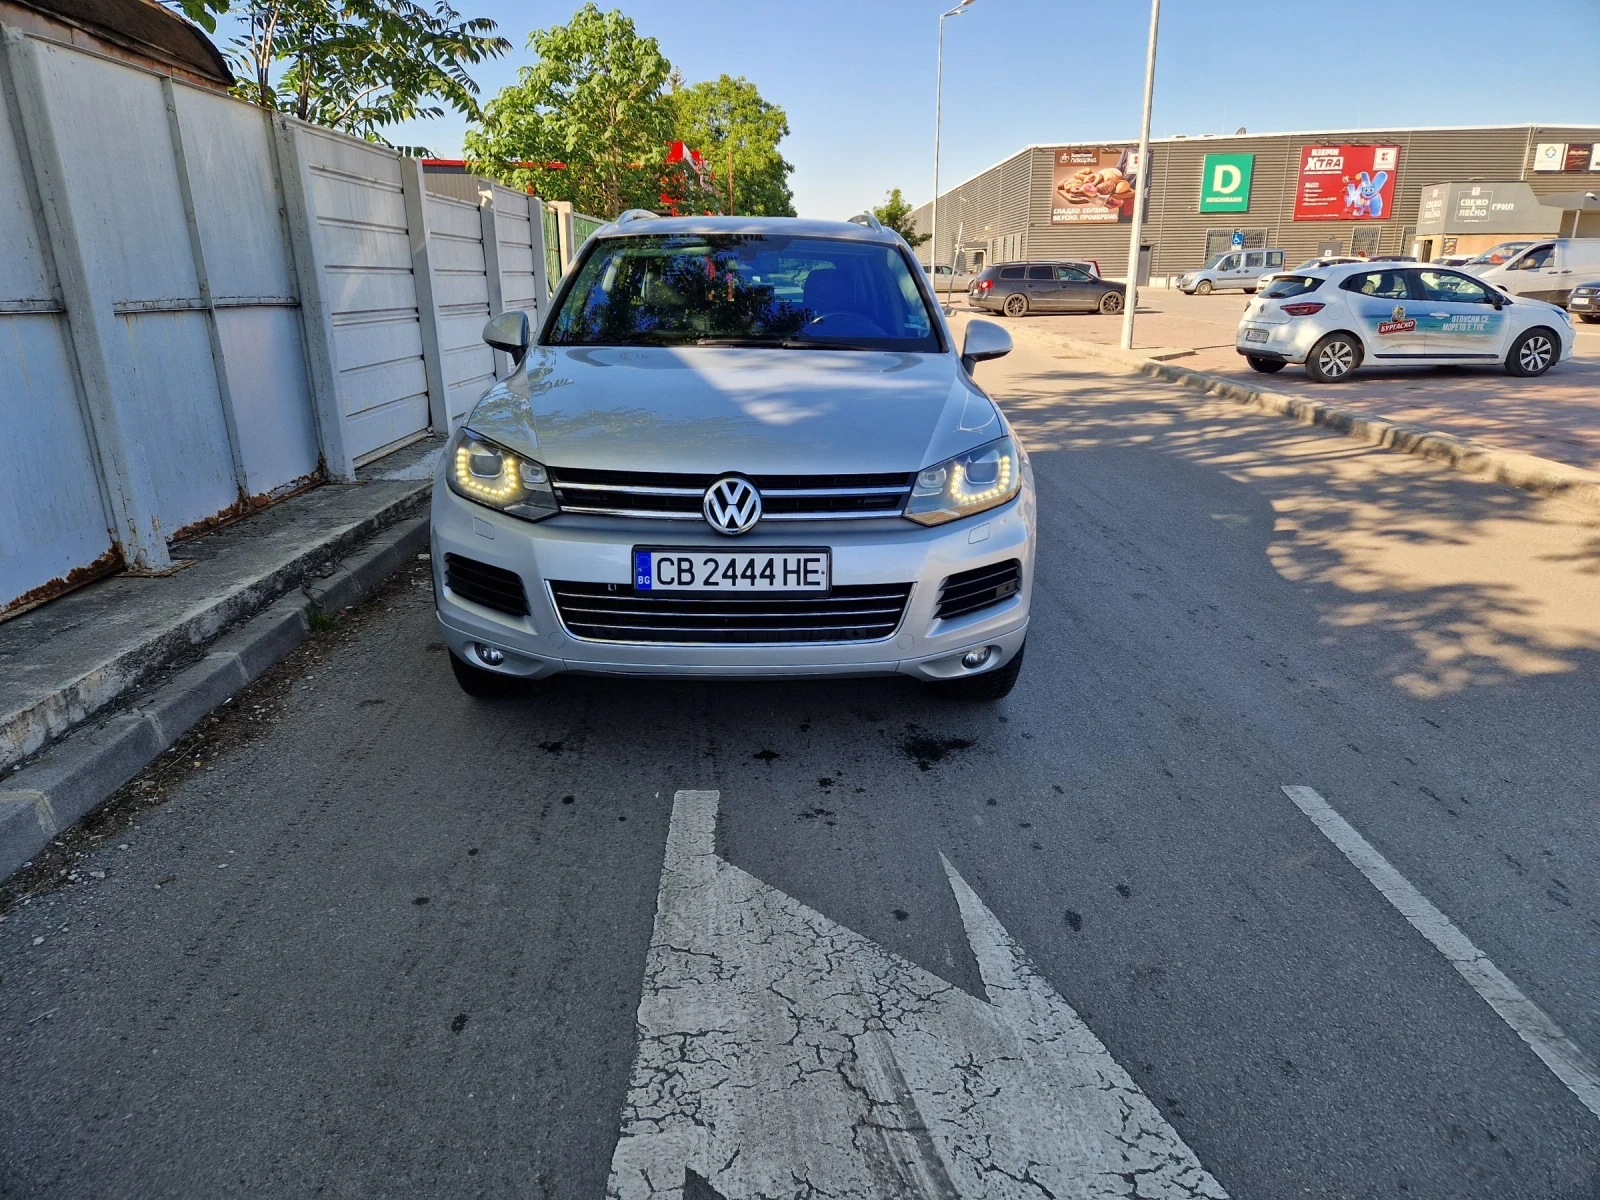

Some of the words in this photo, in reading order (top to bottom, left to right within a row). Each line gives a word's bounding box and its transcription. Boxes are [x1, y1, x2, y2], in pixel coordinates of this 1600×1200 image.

[1304, 156, 1344, 170] XTRA
[1213, 164, 1241, 194] D
[1460, 198, 1488, 206] СВЕЖО
[1053, 207, 1081, 215] СЛАДКО.
[1079, 213, 1118, 221] ПРОВЕРЕНО.
[1451, 315, 1480, 323] ОТПУСНИ
[1380, 320, 1414, 332] БУРГАСКО
[1442, 323, 1466, 331] МОРЕТО
[702, 557, 776, 587] 2444
[637, 575, 651, 584] BG
